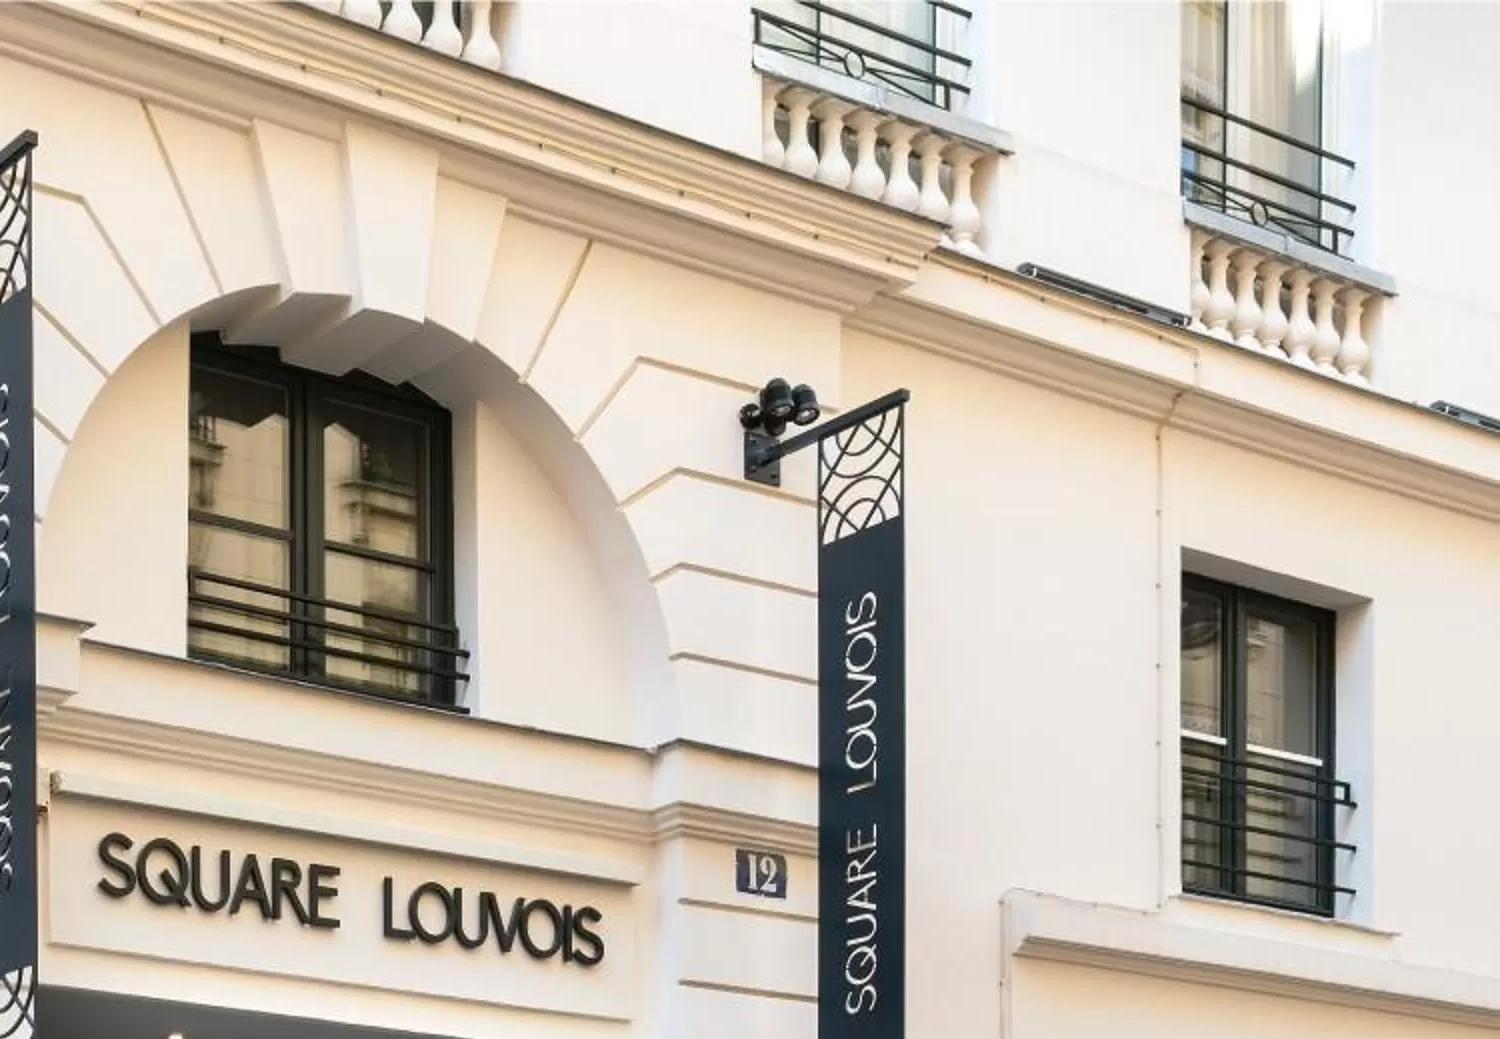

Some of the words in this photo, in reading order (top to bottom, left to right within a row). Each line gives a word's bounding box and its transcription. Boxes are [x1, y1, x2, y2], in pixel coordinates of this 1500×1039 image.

[845, 590, 878, 795] LOUVOIS
[98, 832, 342, 930] SQUARE
[382, 876, 606, 967] LOUVOIS
[745, 850, 779, 893] 12
[845, 822, 878, 1015] SQUARE
